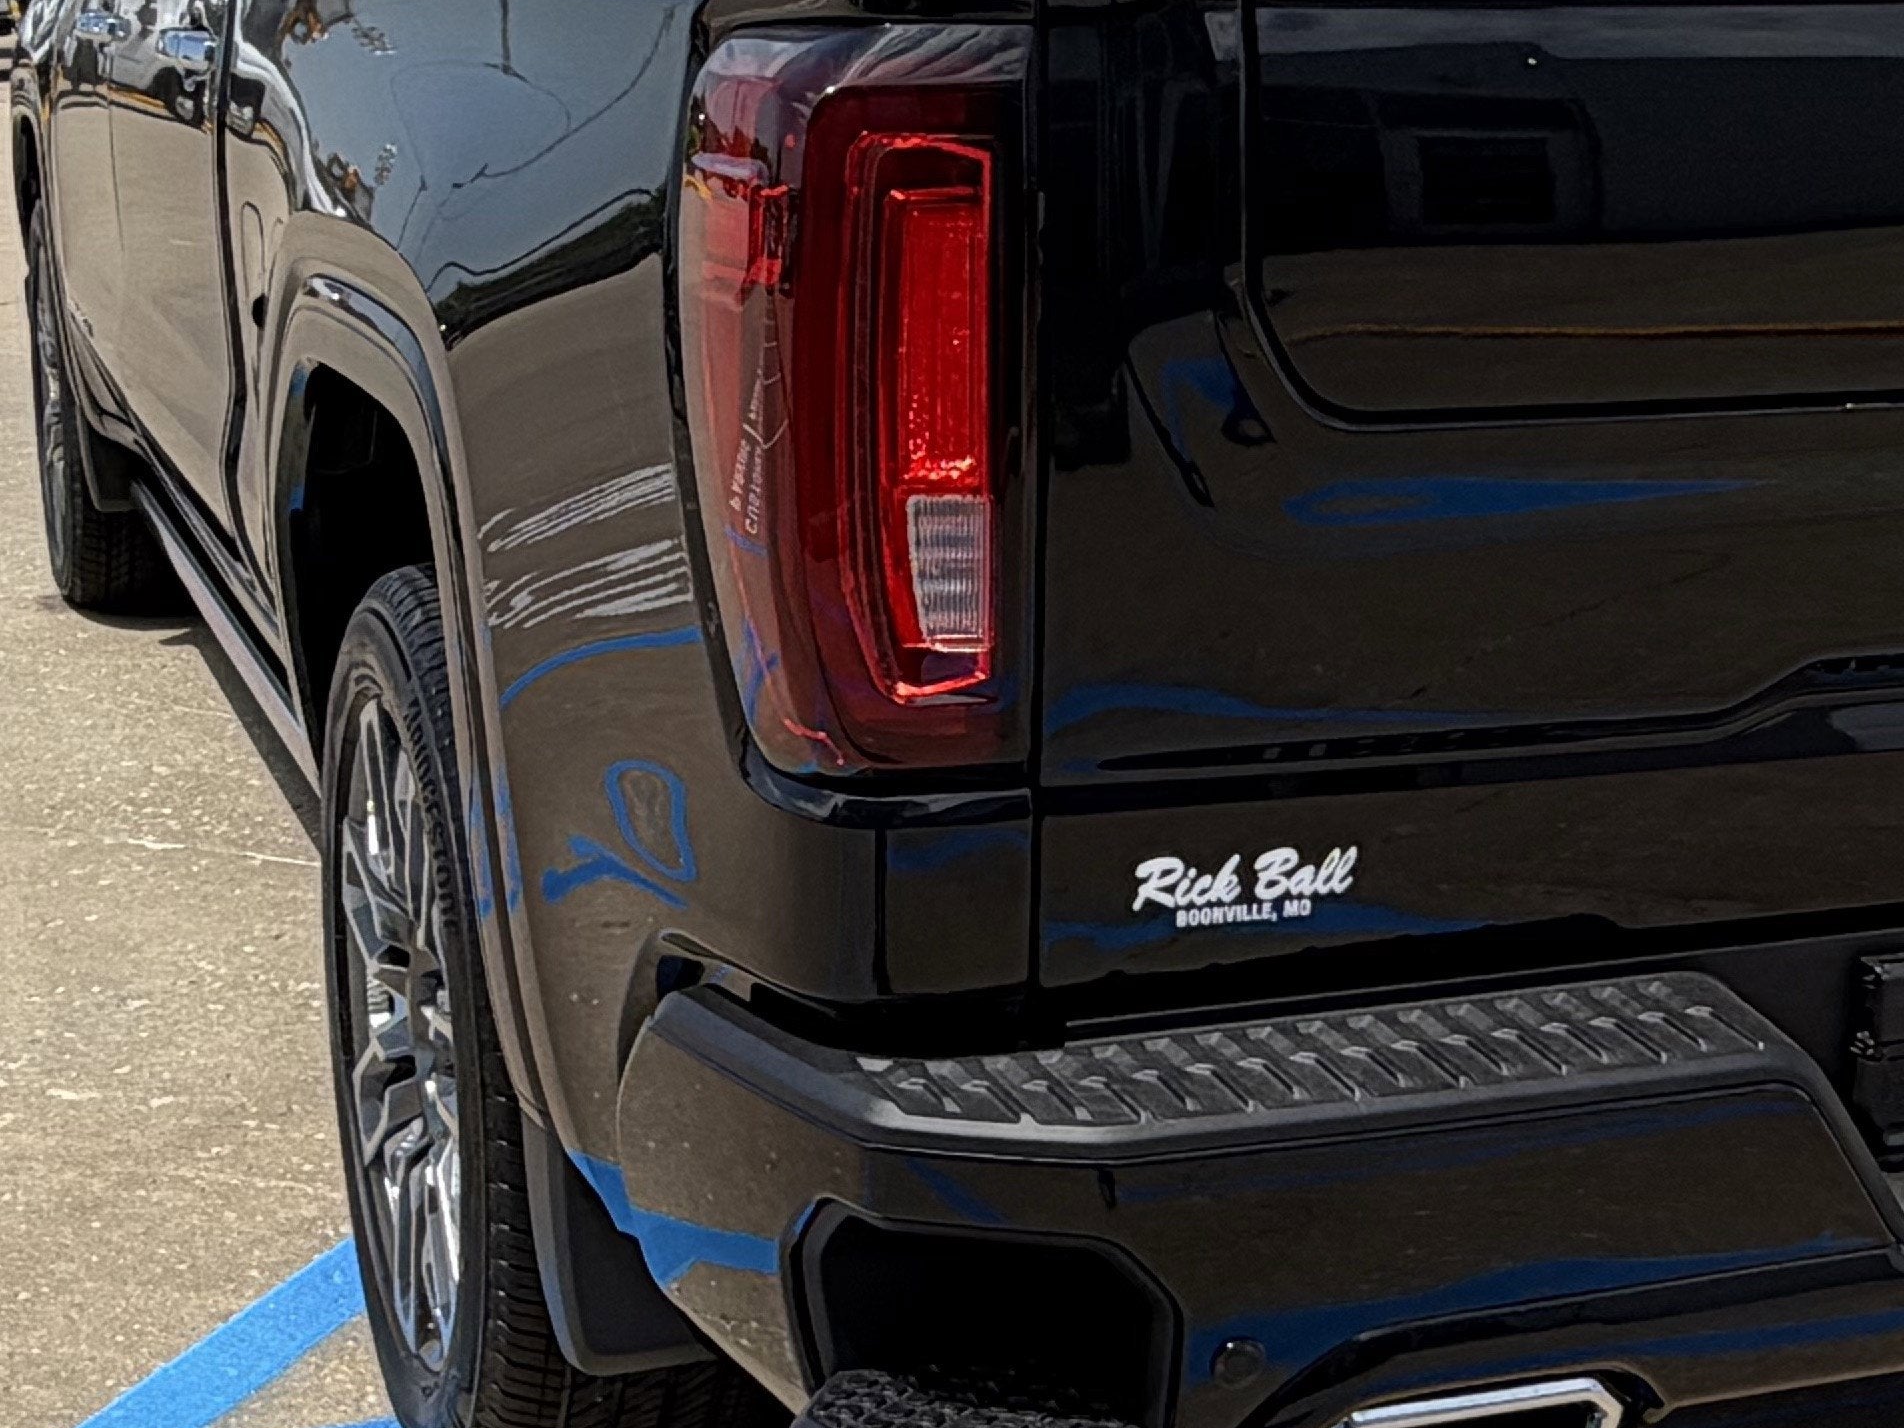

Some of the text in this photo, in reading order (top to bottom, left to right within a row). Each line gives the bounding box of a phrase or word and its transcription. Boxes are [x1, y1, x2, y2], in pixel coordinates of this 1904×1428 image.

[1132, 845, 1358, 912] Rick Ball
[1175, 899, 1312, 928] BOONVILLE, MO
